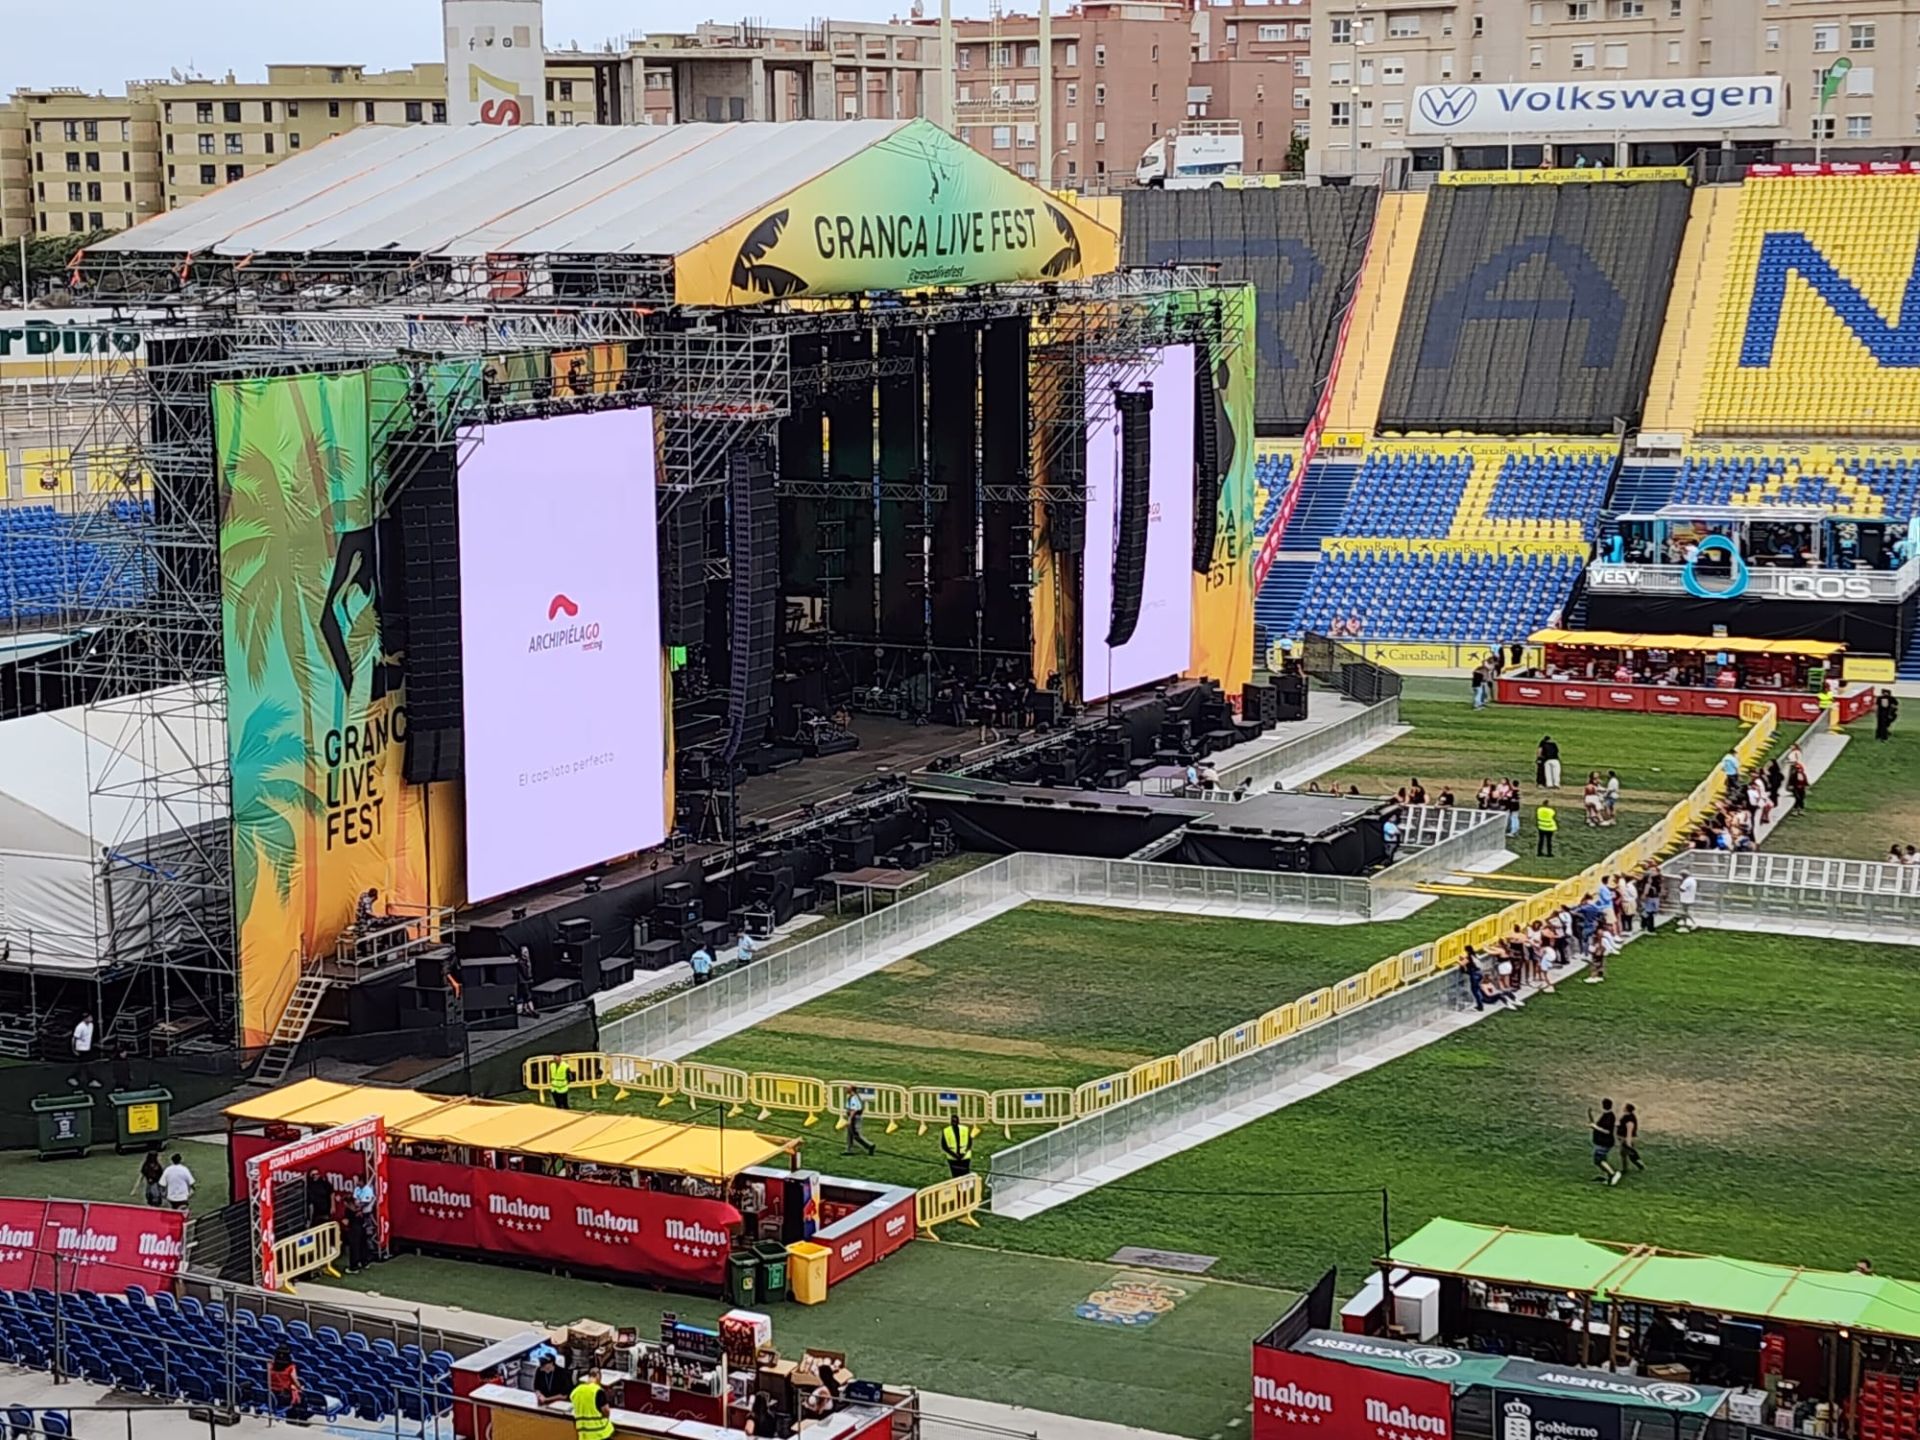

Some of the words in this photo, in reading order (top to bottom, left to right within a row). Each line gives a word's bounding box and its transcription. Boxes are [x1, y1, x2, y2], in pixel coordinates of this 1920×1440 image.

[1497, 84, 1774, 117] Volkswagen
[1460, 172, 1509, 183] CaixaBank
[1543, 171, 1594, 182] CaixaBank
[1627, 169, 1678, 180] CaixaBank
[814, 214, 928, 259] GRANCA
[935, 211, 984, 256] LIVE
[991, 208, 1036, 252] FEST
[1344, 540, 1399, 552] CaixaBank
[1432, 542, 1488, 554] CaixaBank
[1523, 543, 1580, 555] CaixaBank
[1591, 569, 1639, 585] VEEV
[1778, 577, 1871, 599] IQOS
[528, 622, 600, 653] ARCHIPIÉLAGO
[1389, 650, 1447, 661] CaixaBank
[327, 760, 376, 808] LIVE
[327, 797, 383, 851] FEST
[409, 1184, 471, 1208] Mahou
[489, 1194, 551, 1220] Mahou
[576, 1206, 639, 1233] Mahou
[57, 1227, 118, 1252] Mahou
[665, 1218, 727, 1246] Mahou
[1253, 1375, 1333, 1412] Mahou
[1365, 1398, 1446, 1436] Mahou
[1535, 1420, 1598, 1438] Gobierno
